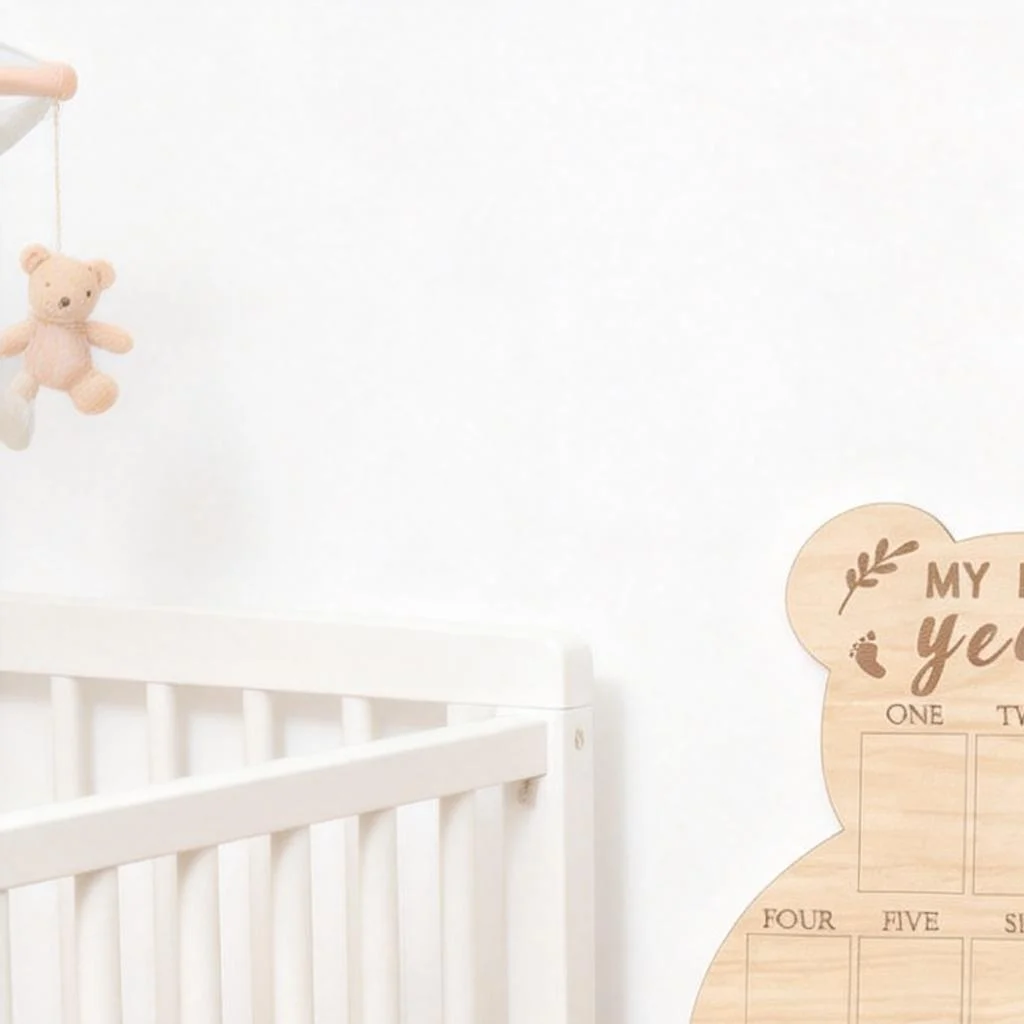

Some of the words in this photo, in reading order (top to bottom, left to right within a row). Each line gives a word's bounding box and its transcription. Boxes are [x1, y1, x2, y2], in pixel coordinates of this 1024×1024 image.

[925, 562, 991, 599] MY
[886, 704, 944, 726] ONE
[763, 908, 837, 931] FOUR
[883, 910, 940, 933] FIVE
